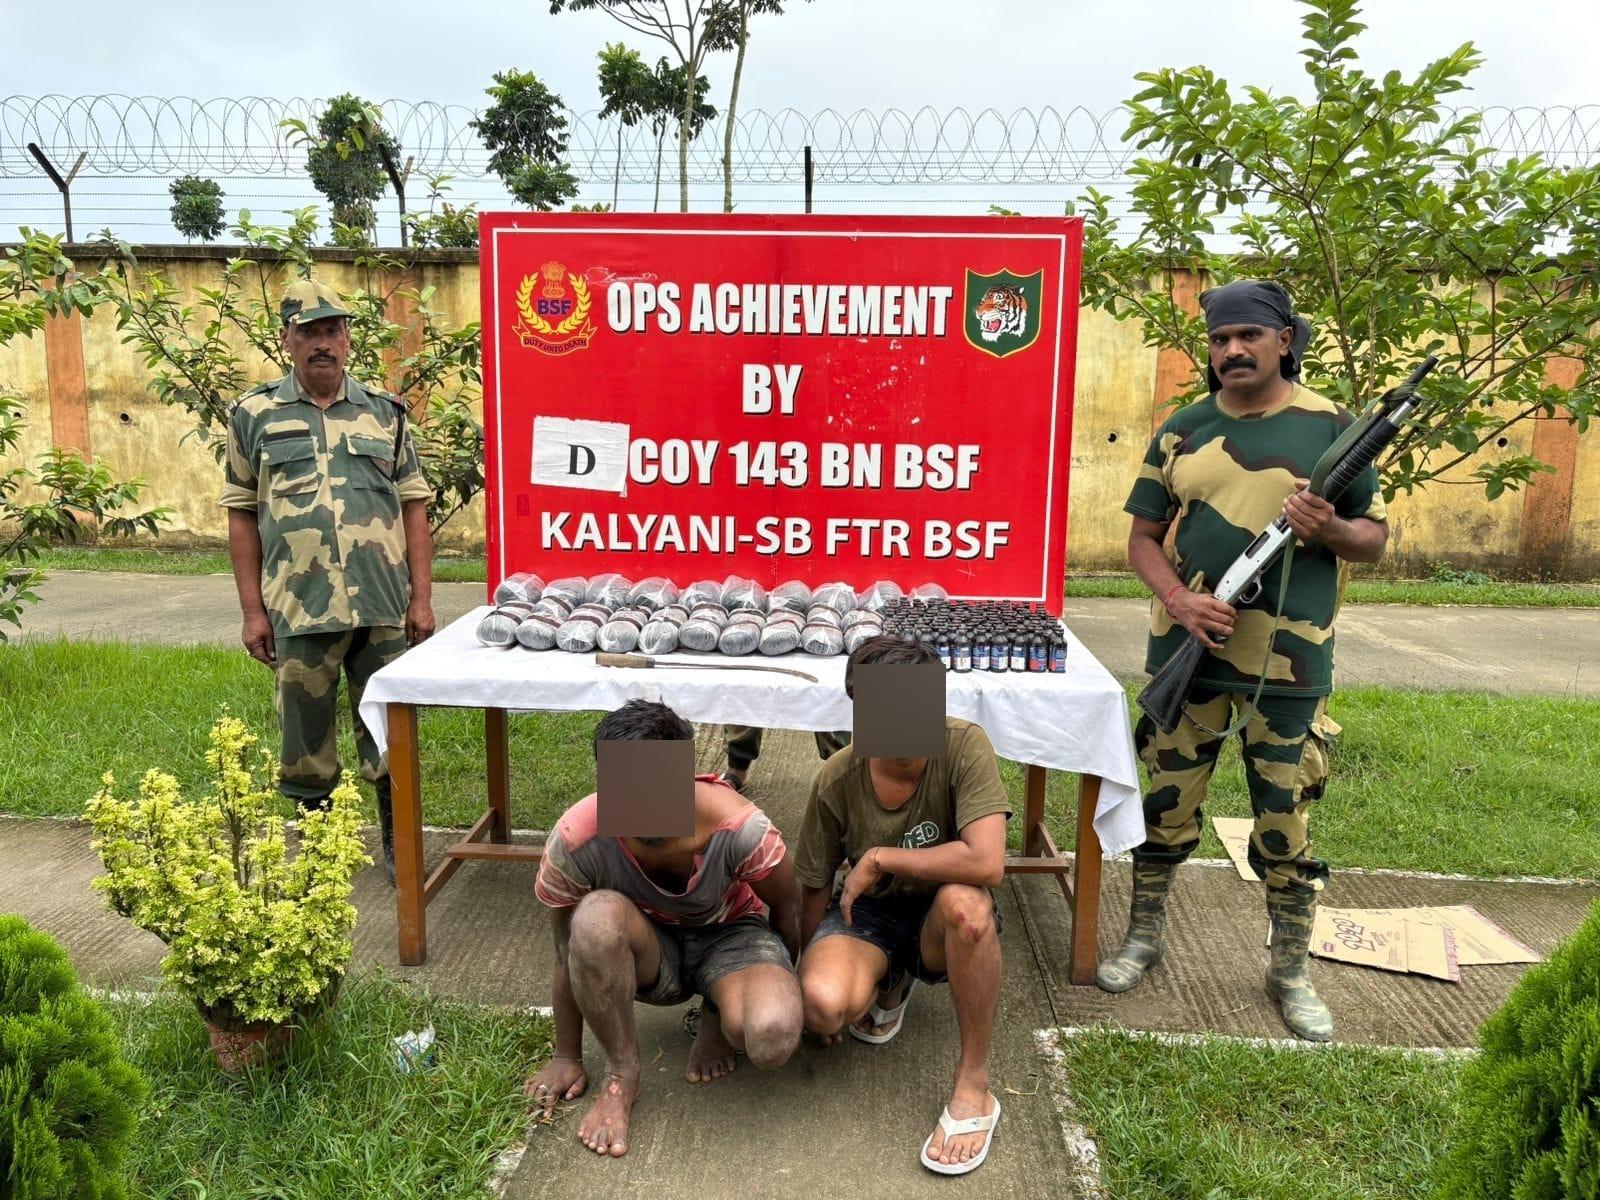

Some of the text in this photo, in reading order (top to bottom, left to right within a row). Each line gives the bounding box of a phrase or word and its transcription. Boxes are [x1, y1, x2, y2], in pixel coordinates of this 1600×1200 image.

[537, 299, 571, 315] BSF
[607, 281, 954, 337] OPS ACHIEVEMENT
[524, 338, 586, 352] DUTY UNTO DEATH
[742, 363, 804, 415] BY
[566, 438, 981, 491] D COY 143 BN BSF
[541, 511, 1011, 560] KALYANI-SB FTR BSF
